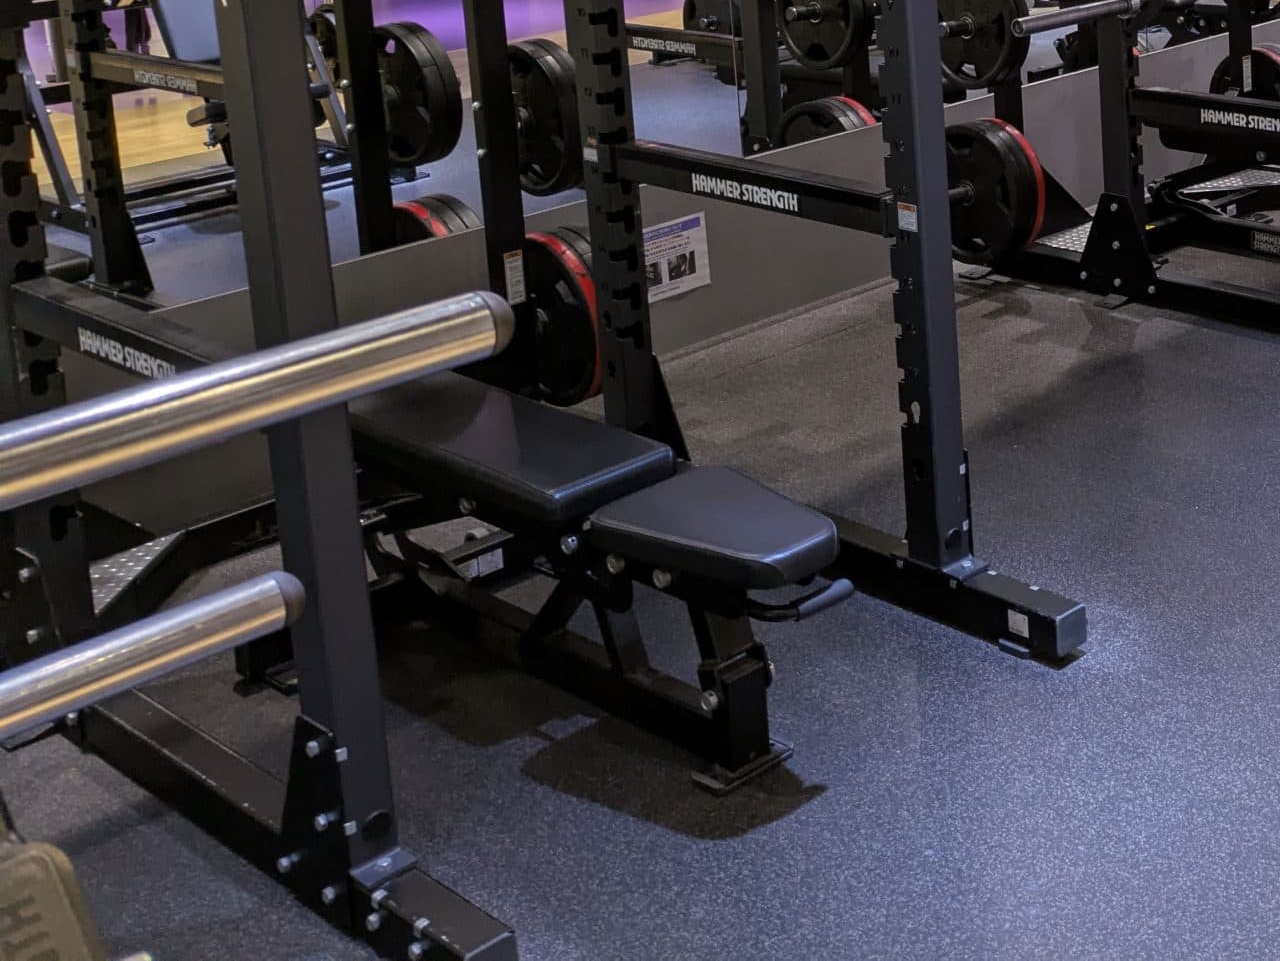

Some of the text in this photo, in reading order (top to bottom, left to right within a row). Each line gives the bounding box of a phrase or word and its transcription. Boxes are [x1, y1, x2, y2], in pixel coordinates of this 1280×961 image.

[1200, 108, 1247, 128] HAMMER
[691, 172, 799, 212] HAMMER STRENGTH
[78, 326, 177, 380] HAMMER STRENGTH
